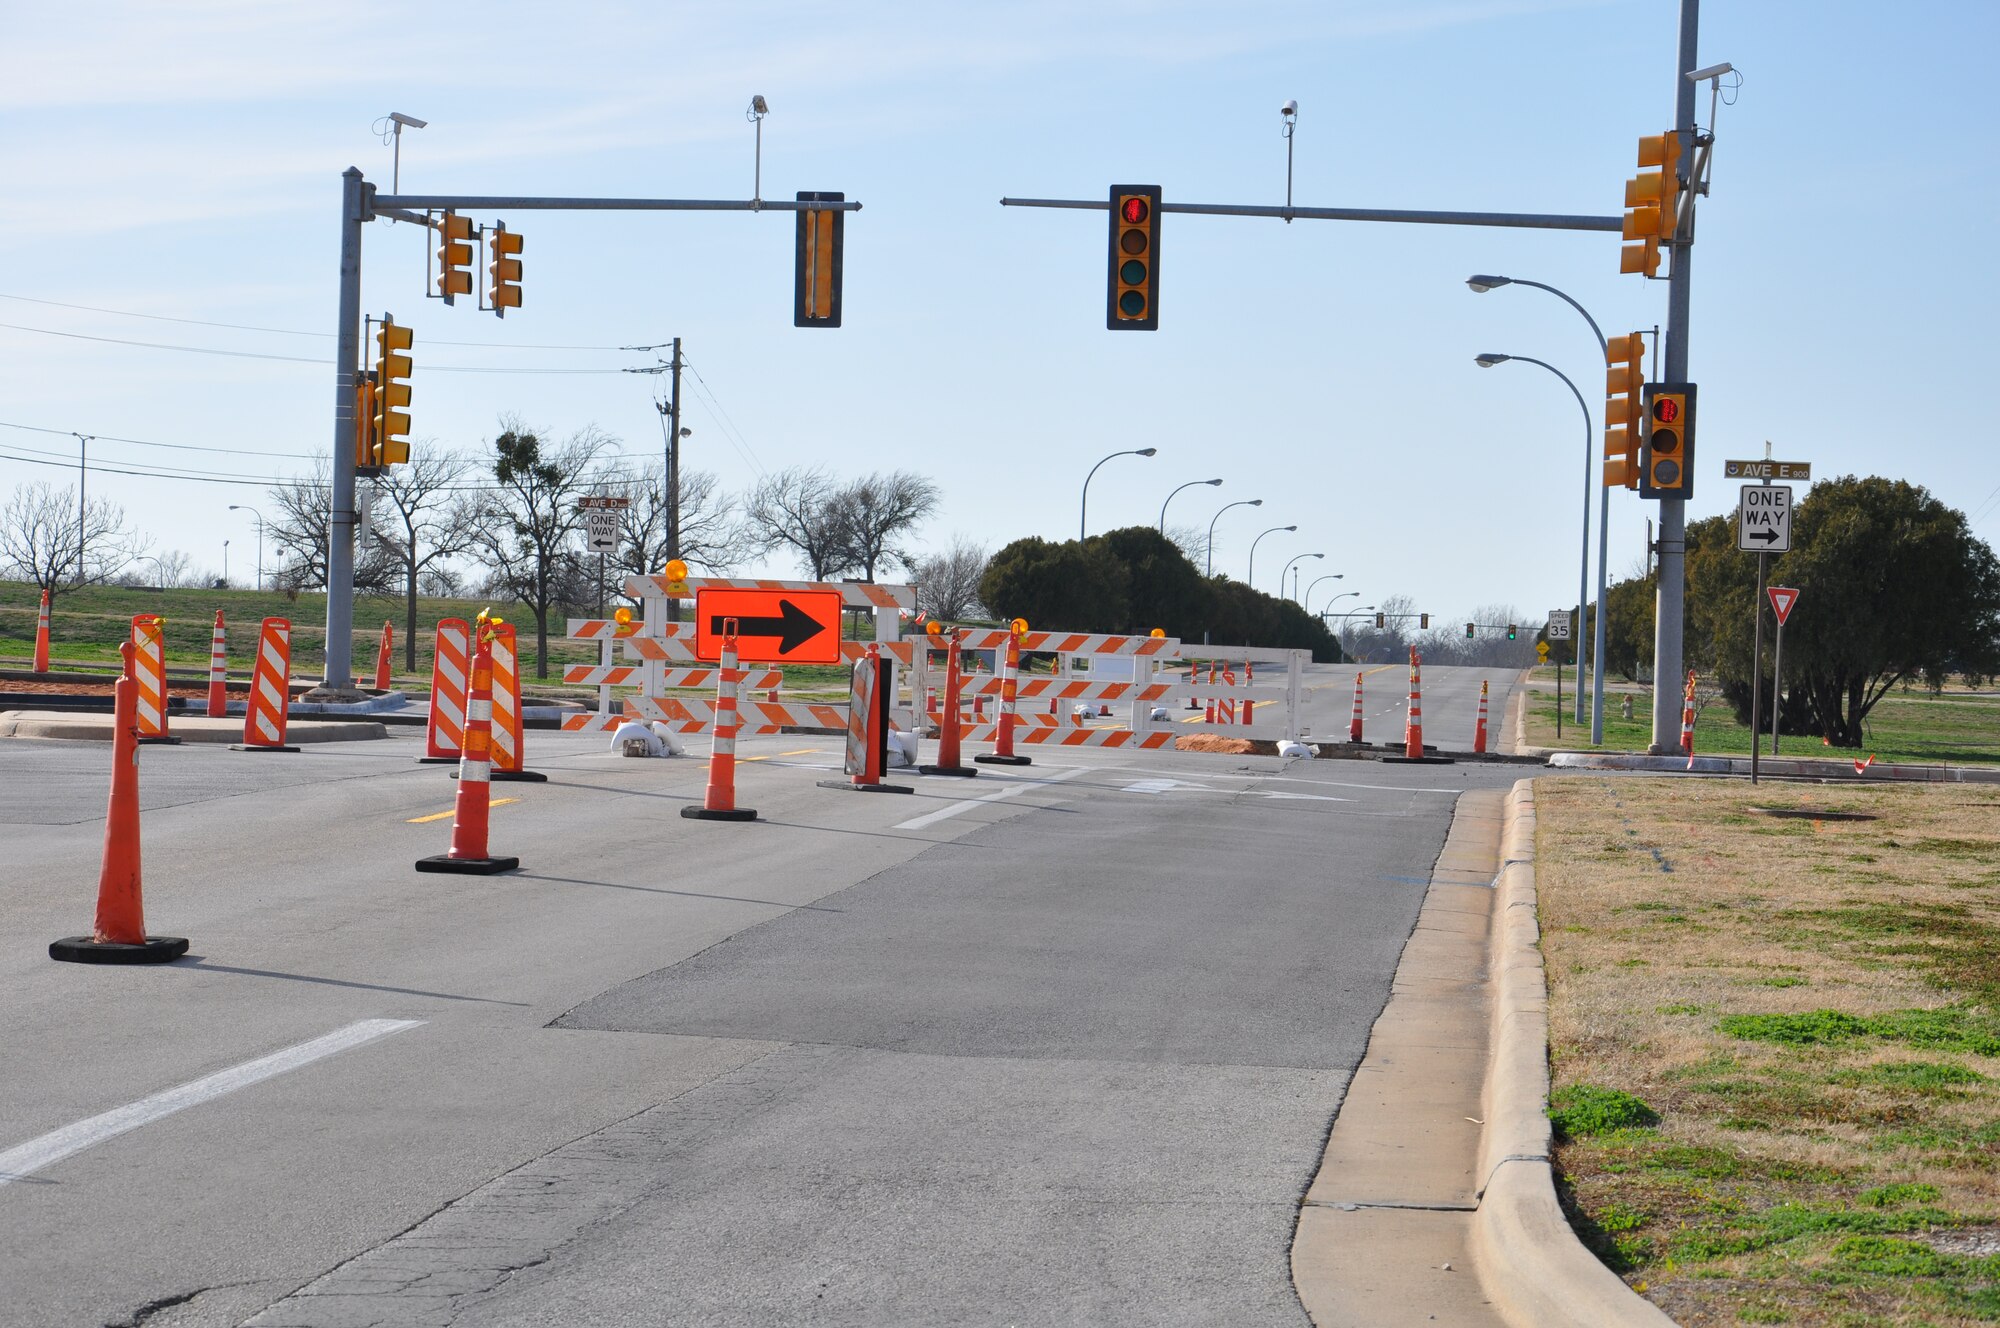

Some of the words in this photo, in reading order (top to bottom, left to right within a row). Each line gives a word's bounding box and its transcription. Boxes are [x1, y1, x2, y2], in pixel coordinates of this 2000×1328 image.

[1743, 464, 1772, 477] AVE
[1780, 465, 1790, 477] E
[1793, 470, 1808, 478] 900
[589, 499, 606, 507] AVE
[1748, 491, 1784, 506] ONE
[591, 515, 615, 525] ONE
[1746, 511, 1785, 526] WAY
[592, 527, 614, 536] WAY
[1551, 626, 1568, 636] 35
